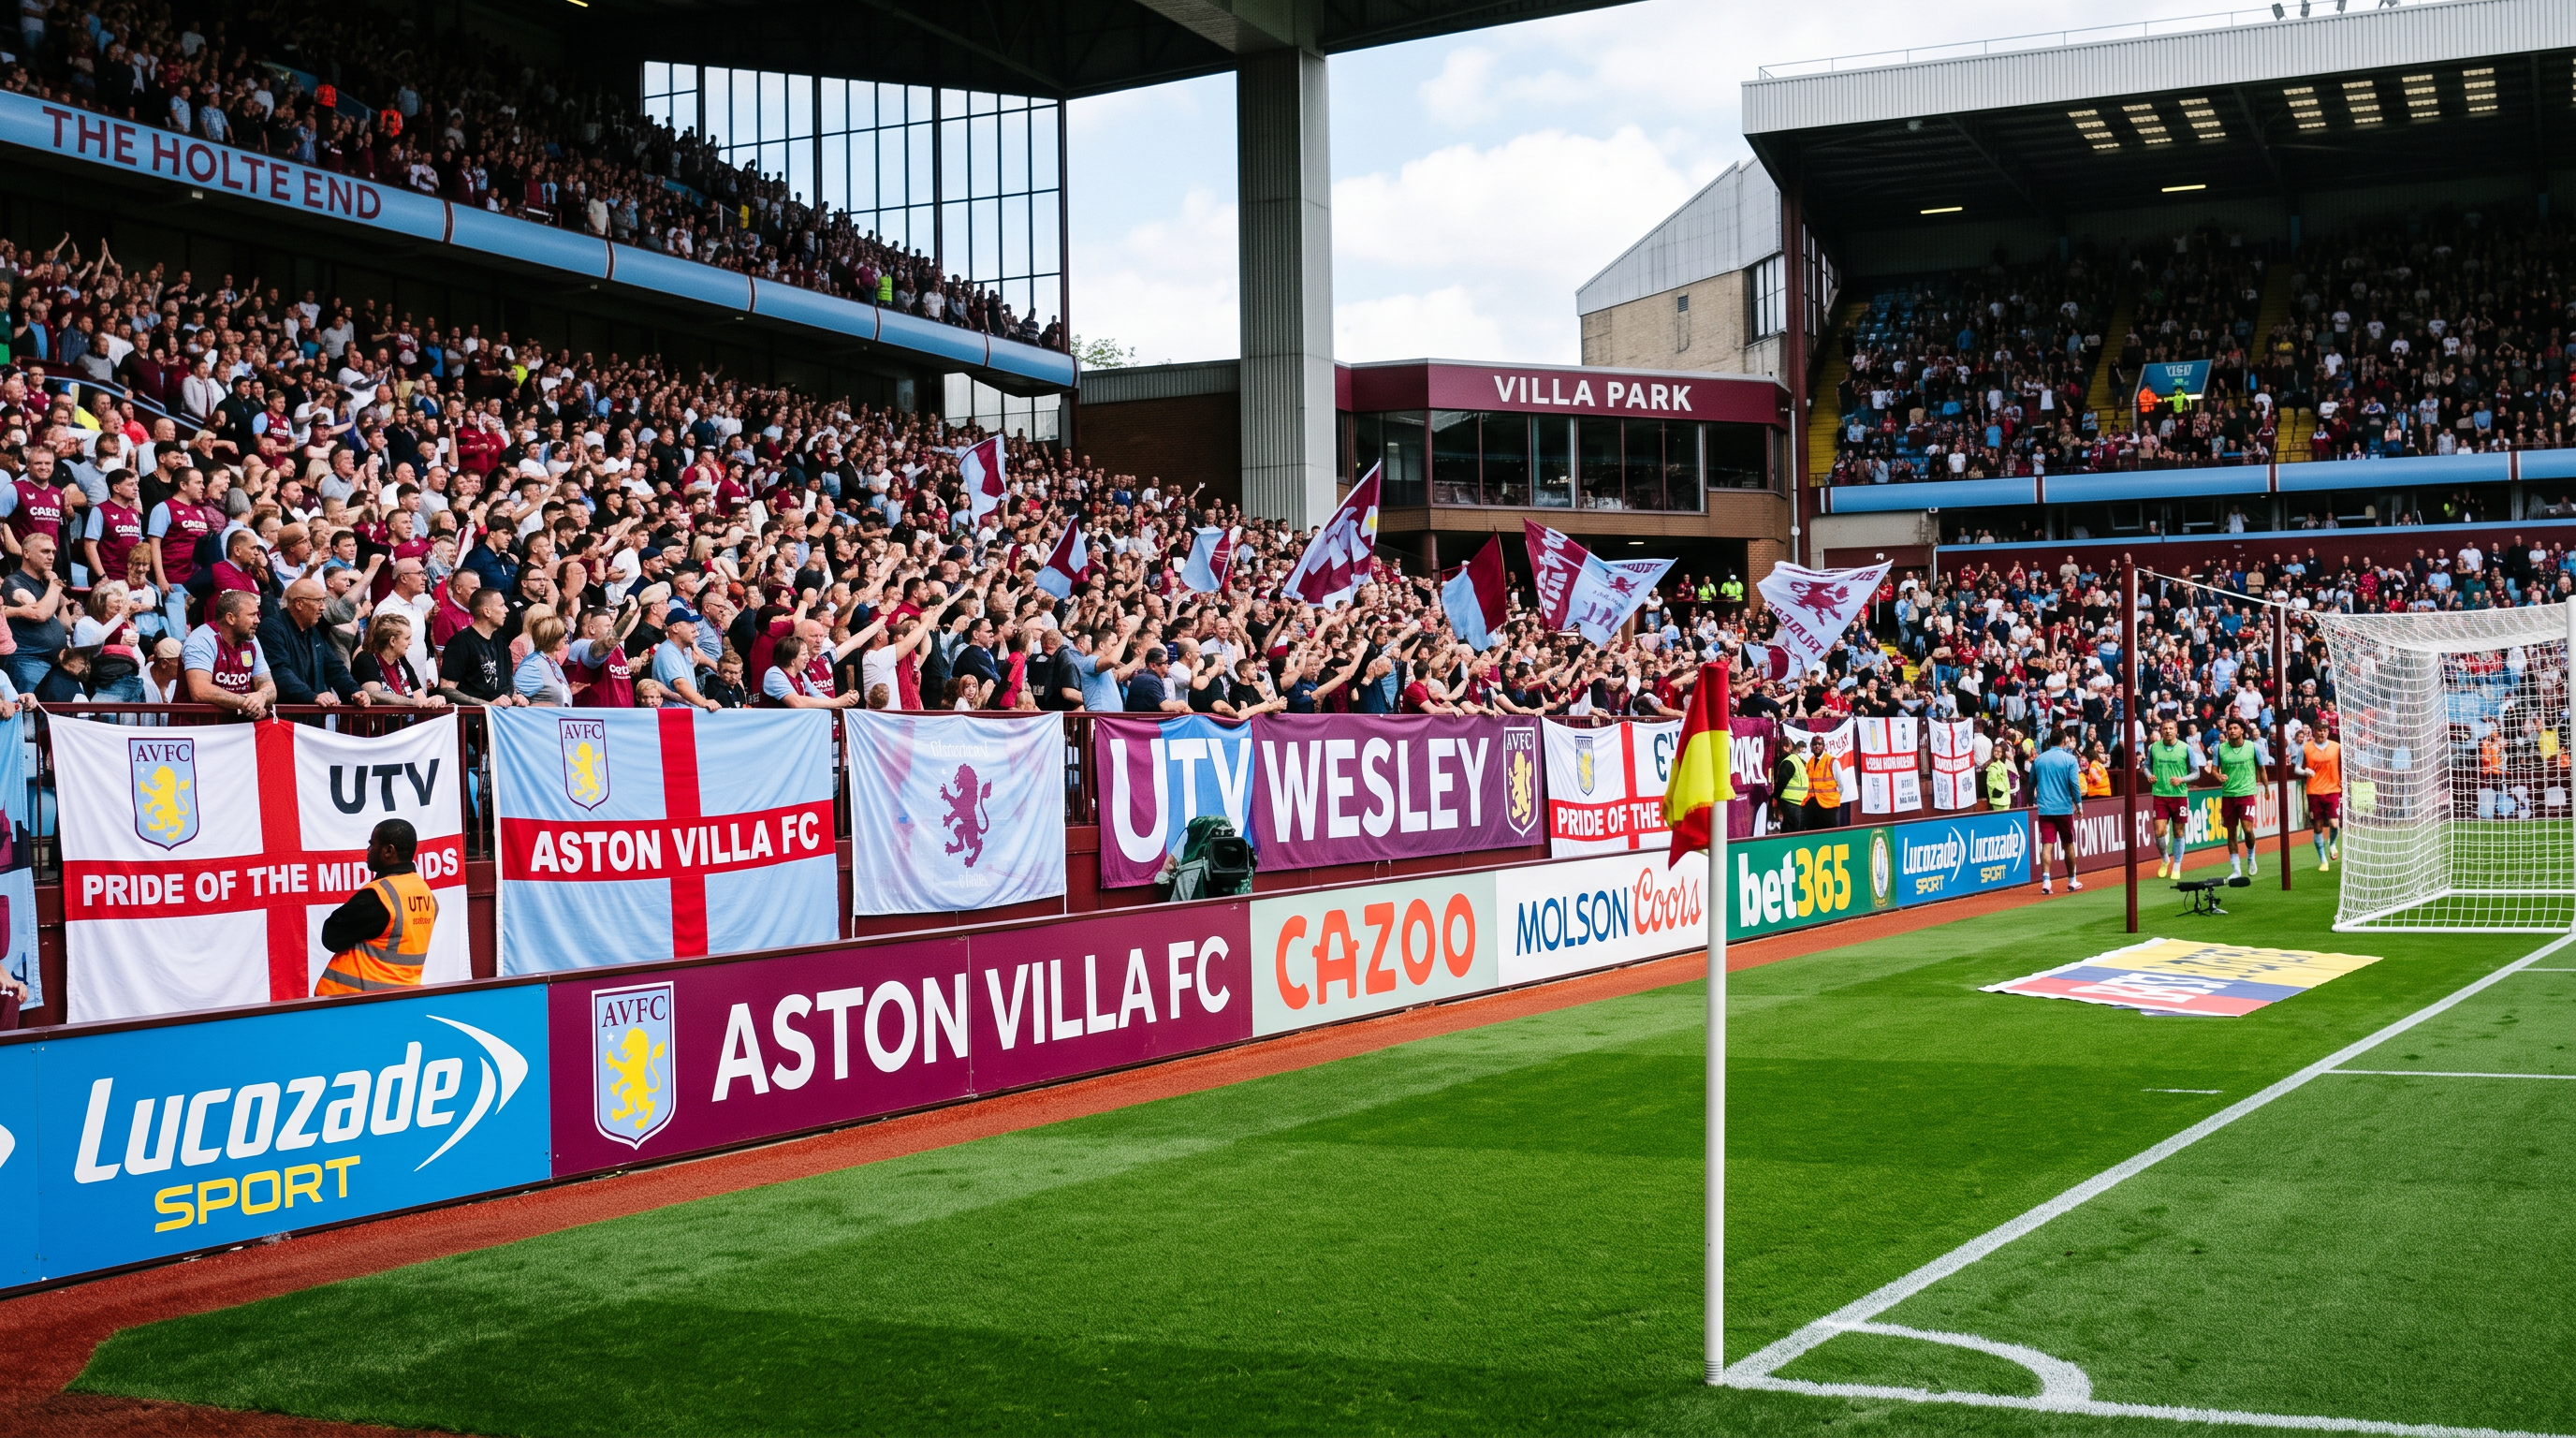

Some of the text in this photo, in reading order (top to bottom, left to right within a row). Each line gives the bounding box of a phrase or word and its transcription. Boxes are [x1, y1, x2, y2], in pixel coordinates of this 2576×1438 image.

[42, 105, 381, 220] THE HOLTE END
[1493, 375, 1692, 412] VILLA PARK
[135, 743, 190, 763] AVFC
[564, 724, 602, 740] AVFC
[329, 757, 440, 814] UTV
[1109, 738, 1252, 863] UTV
[1262, 737, 1489, 843] WESLEY
[531, 812, 820, 873] ASTON VILLA FC
[1557, 801, 1661, 836] PRIDE OF THE
[1969, 825, 2019, 864] Lucozade
[2098, 814, 2127, 854] VILL
[2135, 810, 2151, 848] FC
[2185, 797, 2228, 844] bet36
[82, 846, 459, 907] PRIDE OF THE MIDNDS
[1903, 832, 1957, 875] Lucozade
[408, 896, 431, 912] UTV
[1515, 867, 1703, 956] MOLSON Coors
[1737, 844, 1852, 928] bet365
[1915, 874, 1944, 895] SPORT
[1275, 892, 1476, 1010] CAZOO
[601, 994, 666, 1030] AVFC
[711, 935, 1231, 1102] ASTON VILLA FC
[74, 1040, 463, 1183] Lucozade
[154, 1155, 361, 1232] SPORT
